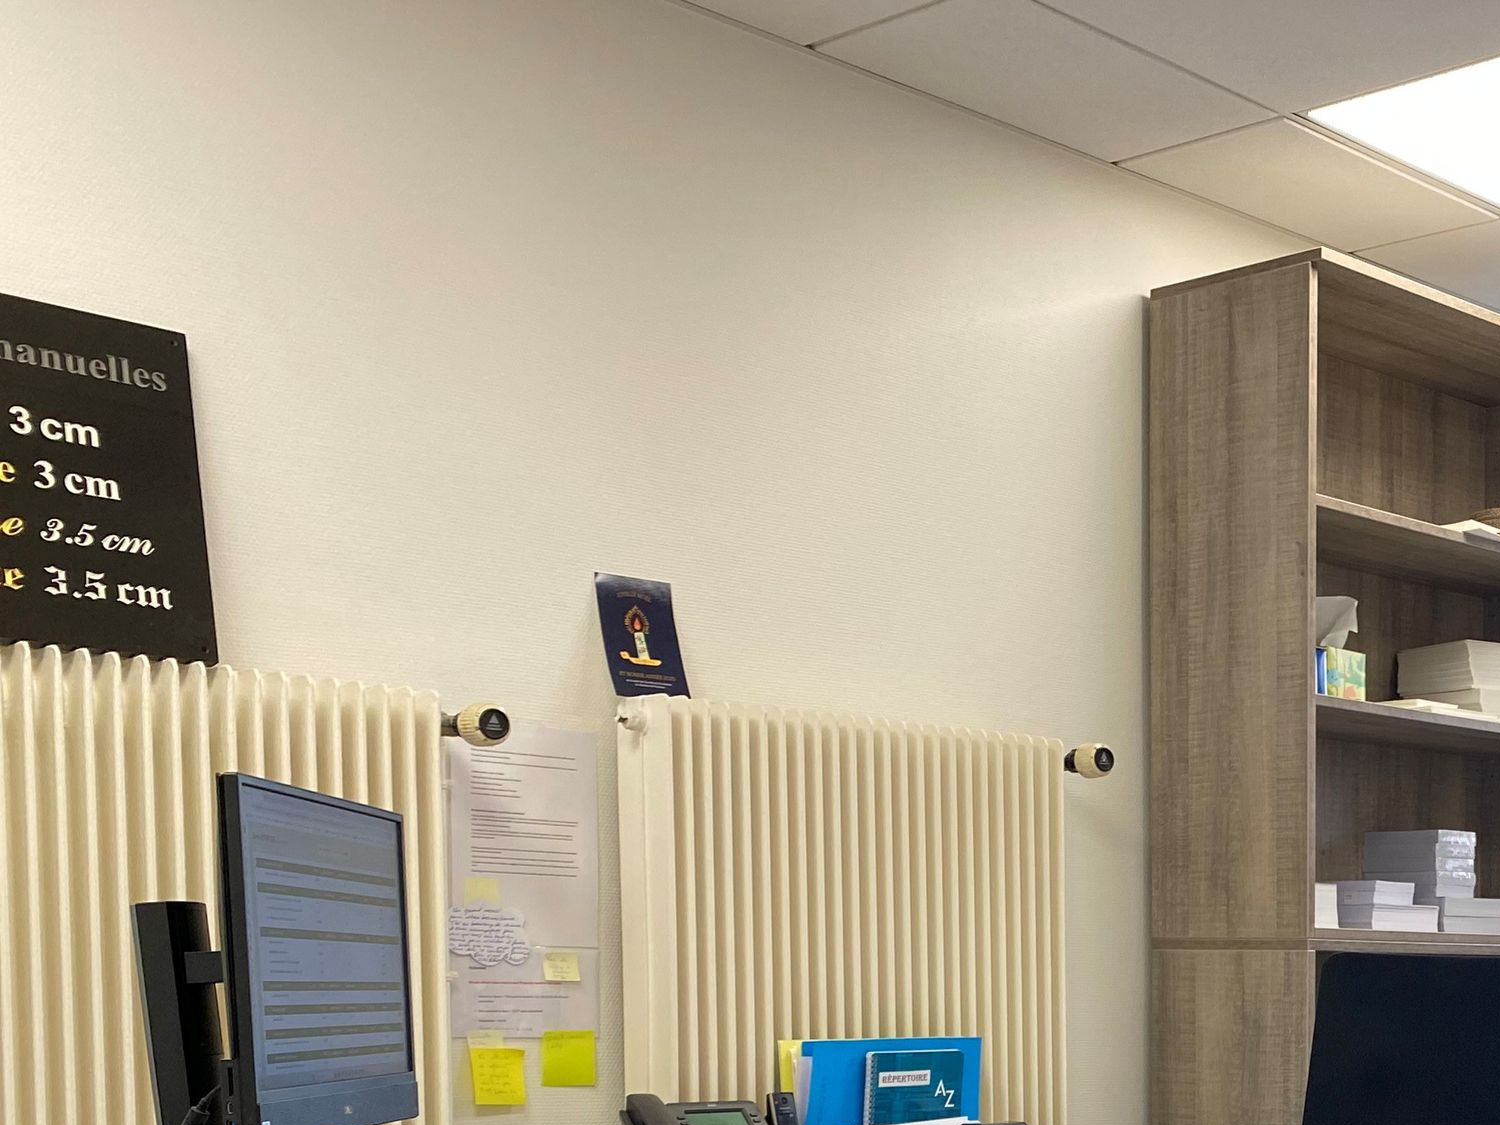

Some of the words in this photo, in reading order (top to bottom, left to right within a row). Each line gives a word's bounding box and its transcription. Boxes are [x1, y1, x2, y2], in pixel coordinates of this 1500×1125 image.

[9, 405, 32, 435] 3
[40, 418, 100, 448] cm
[33, 460, 56, 489] 3
[64, 472, 121, 501] cm
[40, 518, 97, 547] 3.5
[101, 534, 155, 556] cm
[44, 565, 107, 600] 3.5
[116, 583, 173, 611] cm
